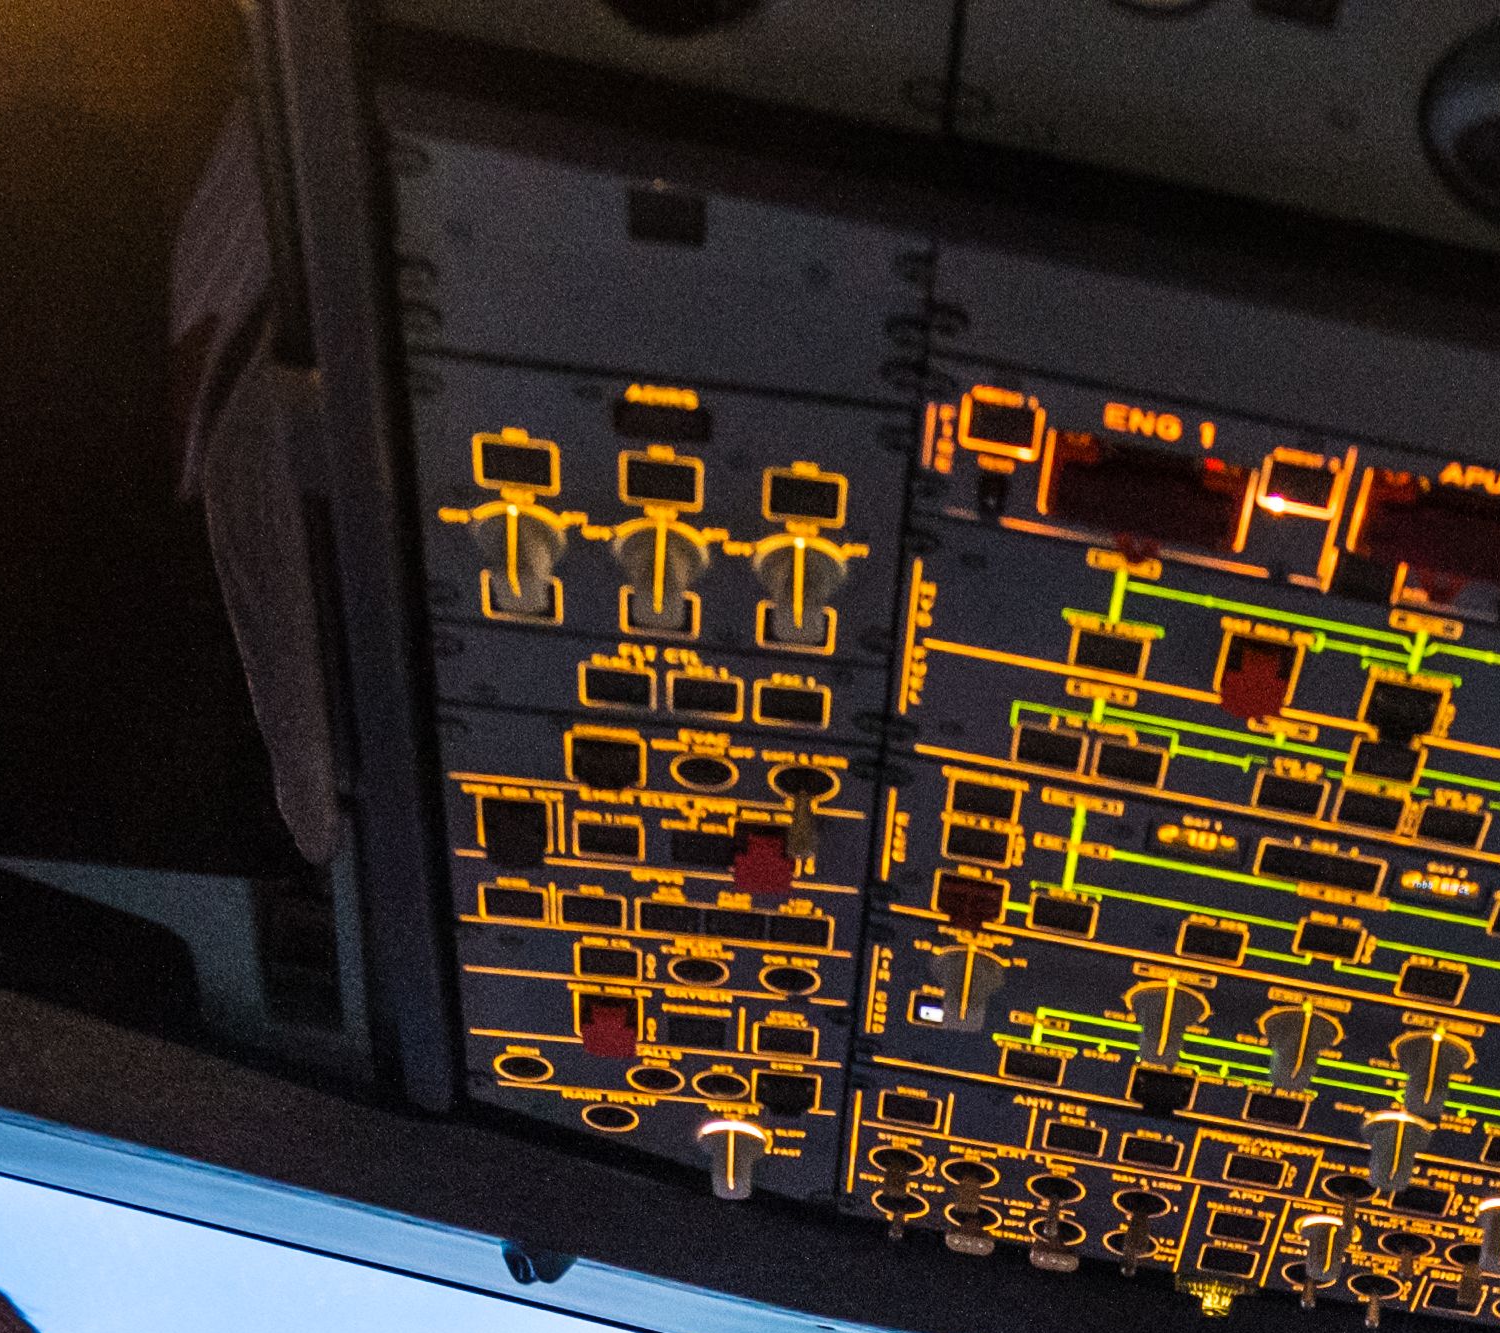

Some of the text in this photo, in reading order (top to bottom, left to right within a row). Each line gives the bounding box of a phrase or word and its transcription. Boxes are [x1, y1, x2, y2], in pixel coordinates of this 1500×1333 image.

[1103, 401, 1216, 448] ENG 1
[1013, 1095, 1087, 1116] ANTI ICE
[1428, 1167, 1483, 1185] PRESS
